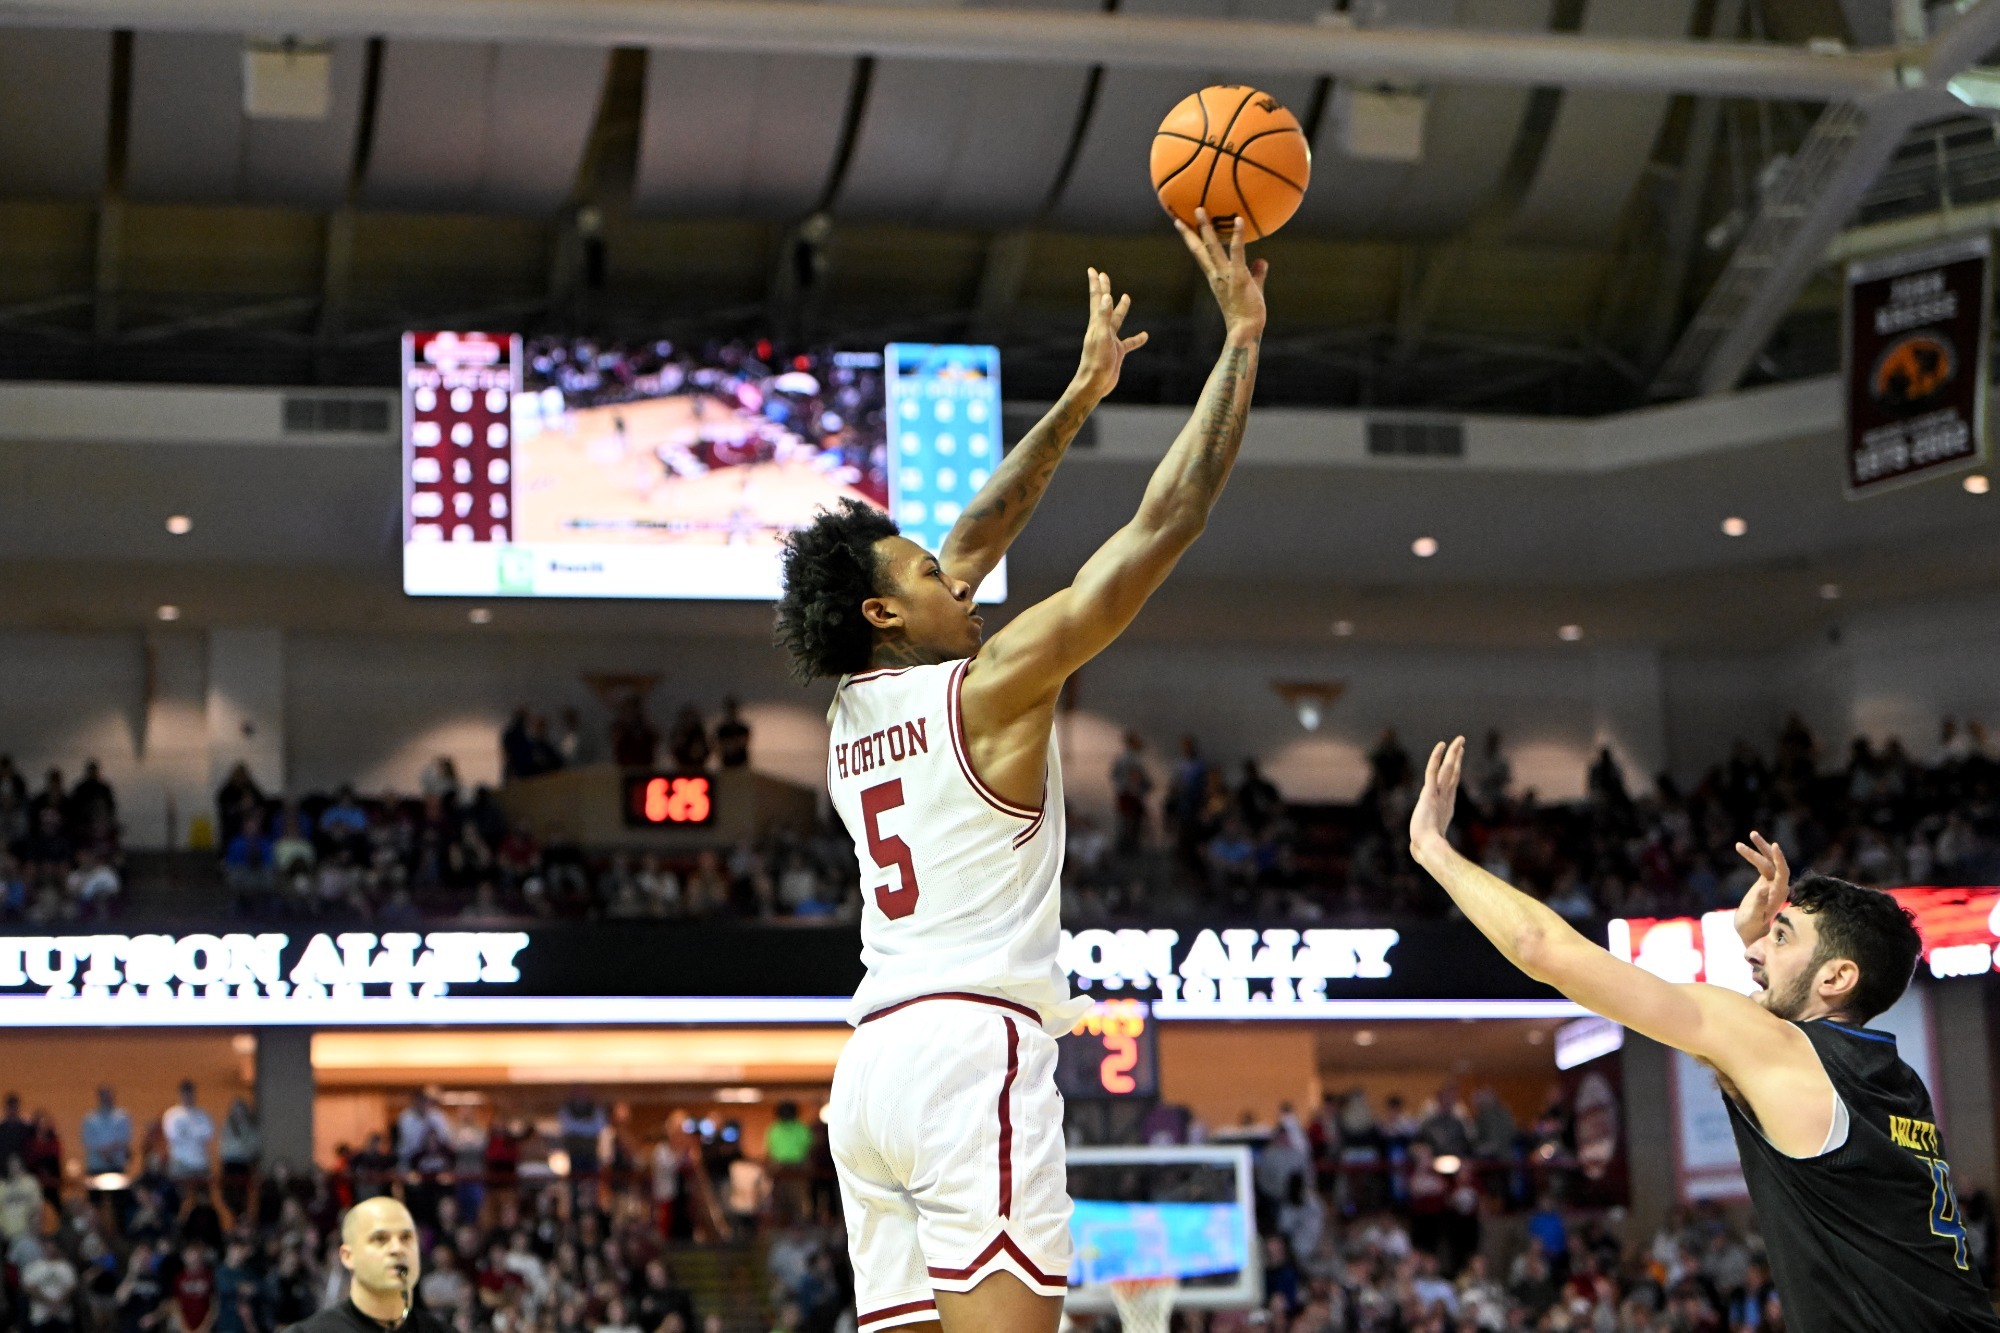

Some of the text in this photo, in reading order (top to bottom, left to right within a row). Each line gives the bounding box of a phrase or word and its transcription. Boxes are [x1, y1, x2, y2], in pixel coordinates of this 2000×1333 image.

[836, 717, 928, 780] HORTON
[860, 777, 920, 921] 5
[290, 932, 530, 984] ALLEY
[1179, 929, 1400, 979] ALLEY
[1100, 1036, 1138, 1093] 2
